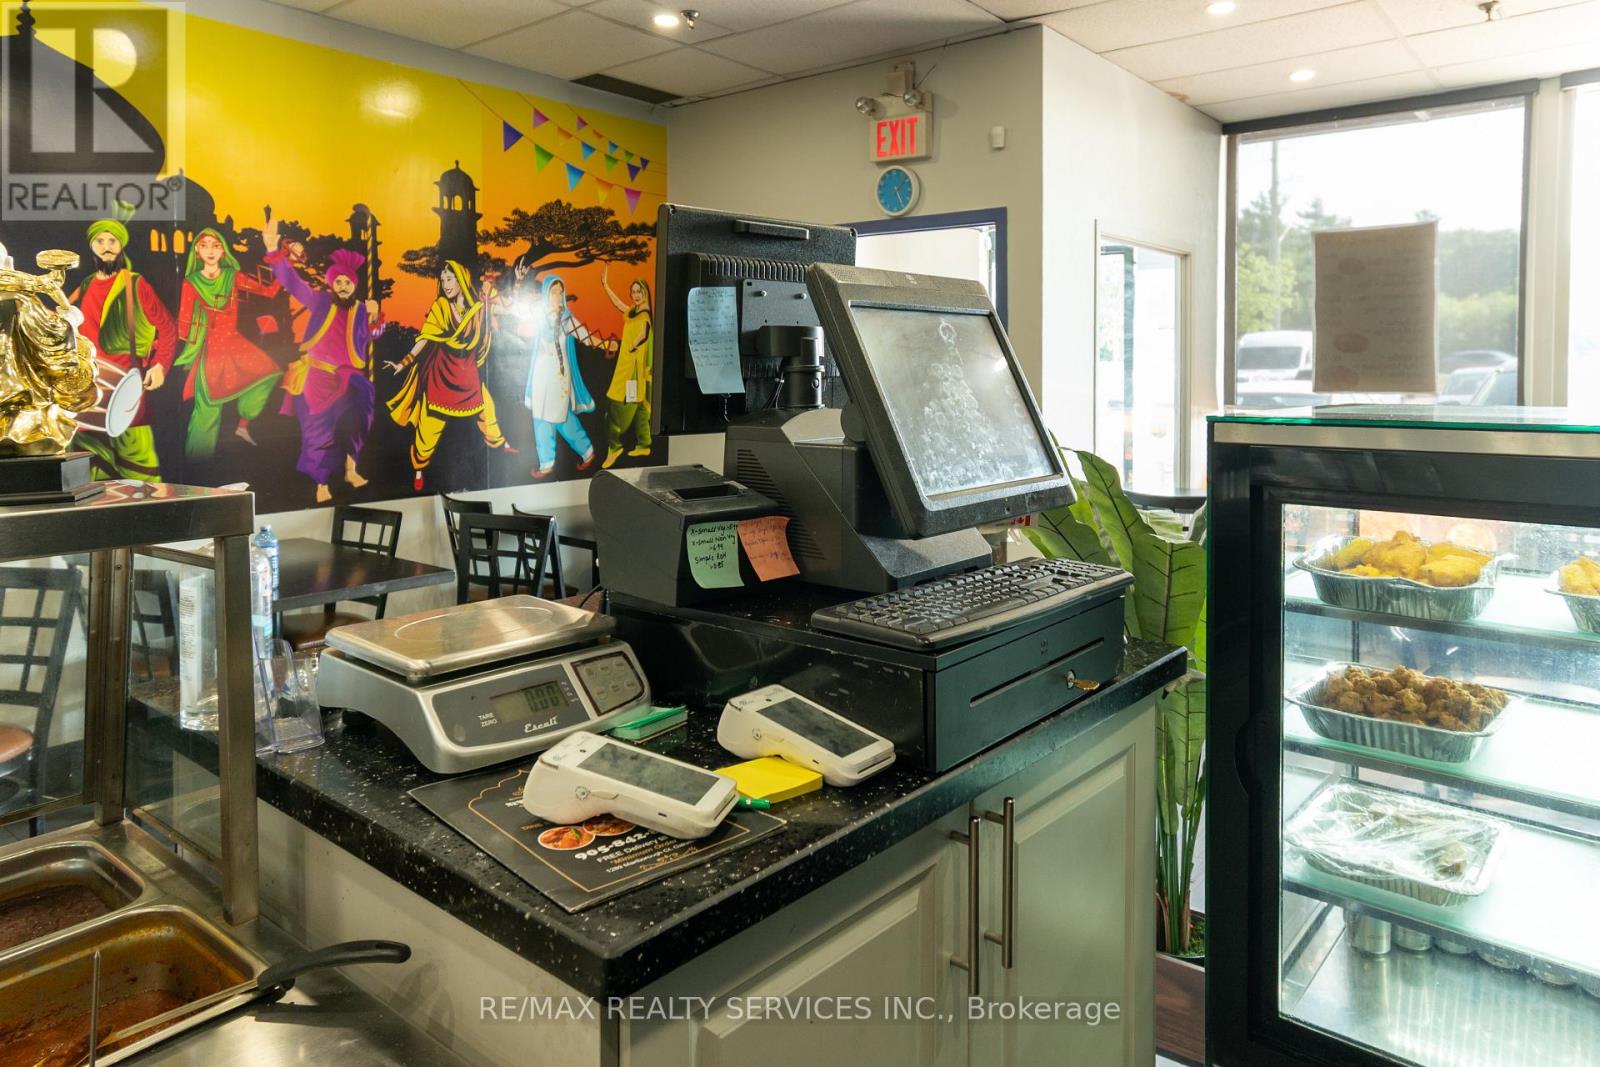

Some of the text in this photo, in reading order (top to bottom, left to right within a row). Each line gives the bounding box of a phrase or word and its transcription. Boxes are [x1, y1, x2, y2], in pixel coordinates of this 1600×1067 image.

[876, 116, 918, 158] EXIT
[478, 712, 494, 721] TARE
[480, 718, 497, 727] ZERO
[596, 839, 658, 864] FREE Delivery
